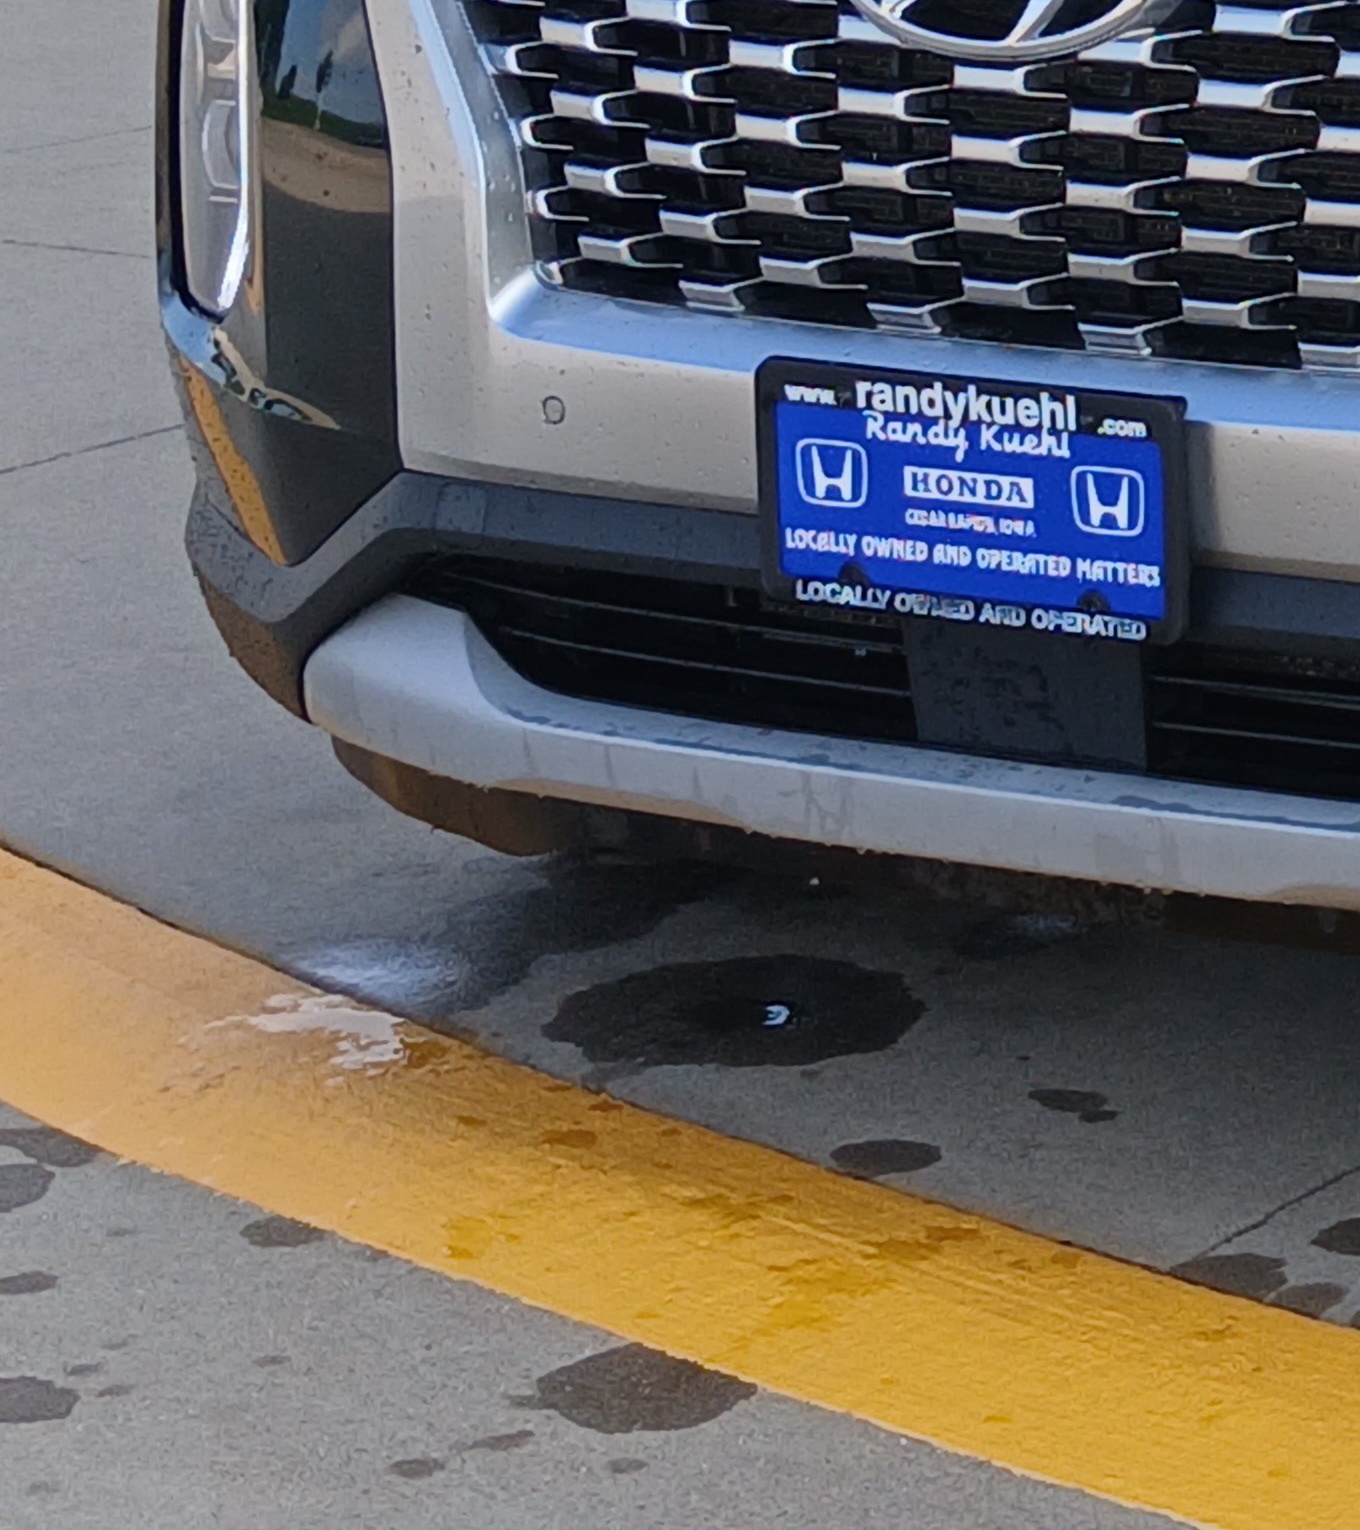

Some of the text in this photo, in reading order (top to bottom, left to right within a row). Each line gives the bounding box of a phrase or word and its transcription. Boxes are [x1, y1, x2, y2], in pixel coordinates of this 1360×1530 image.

[855, 380, 1077, 431] randykuehl
[1097, 418, 1148, 438] .com
[862, 409, 1070, 463] Randy Kuehl
[910, 471, 1028, 503] HONDA
[785, 527, 1161, 587] LOCALLY OWNED AND OPERATED MATTERS
[795, 579, 891, 610] LOCALLY
[1031, 608, 1148, 641] OPERATED
